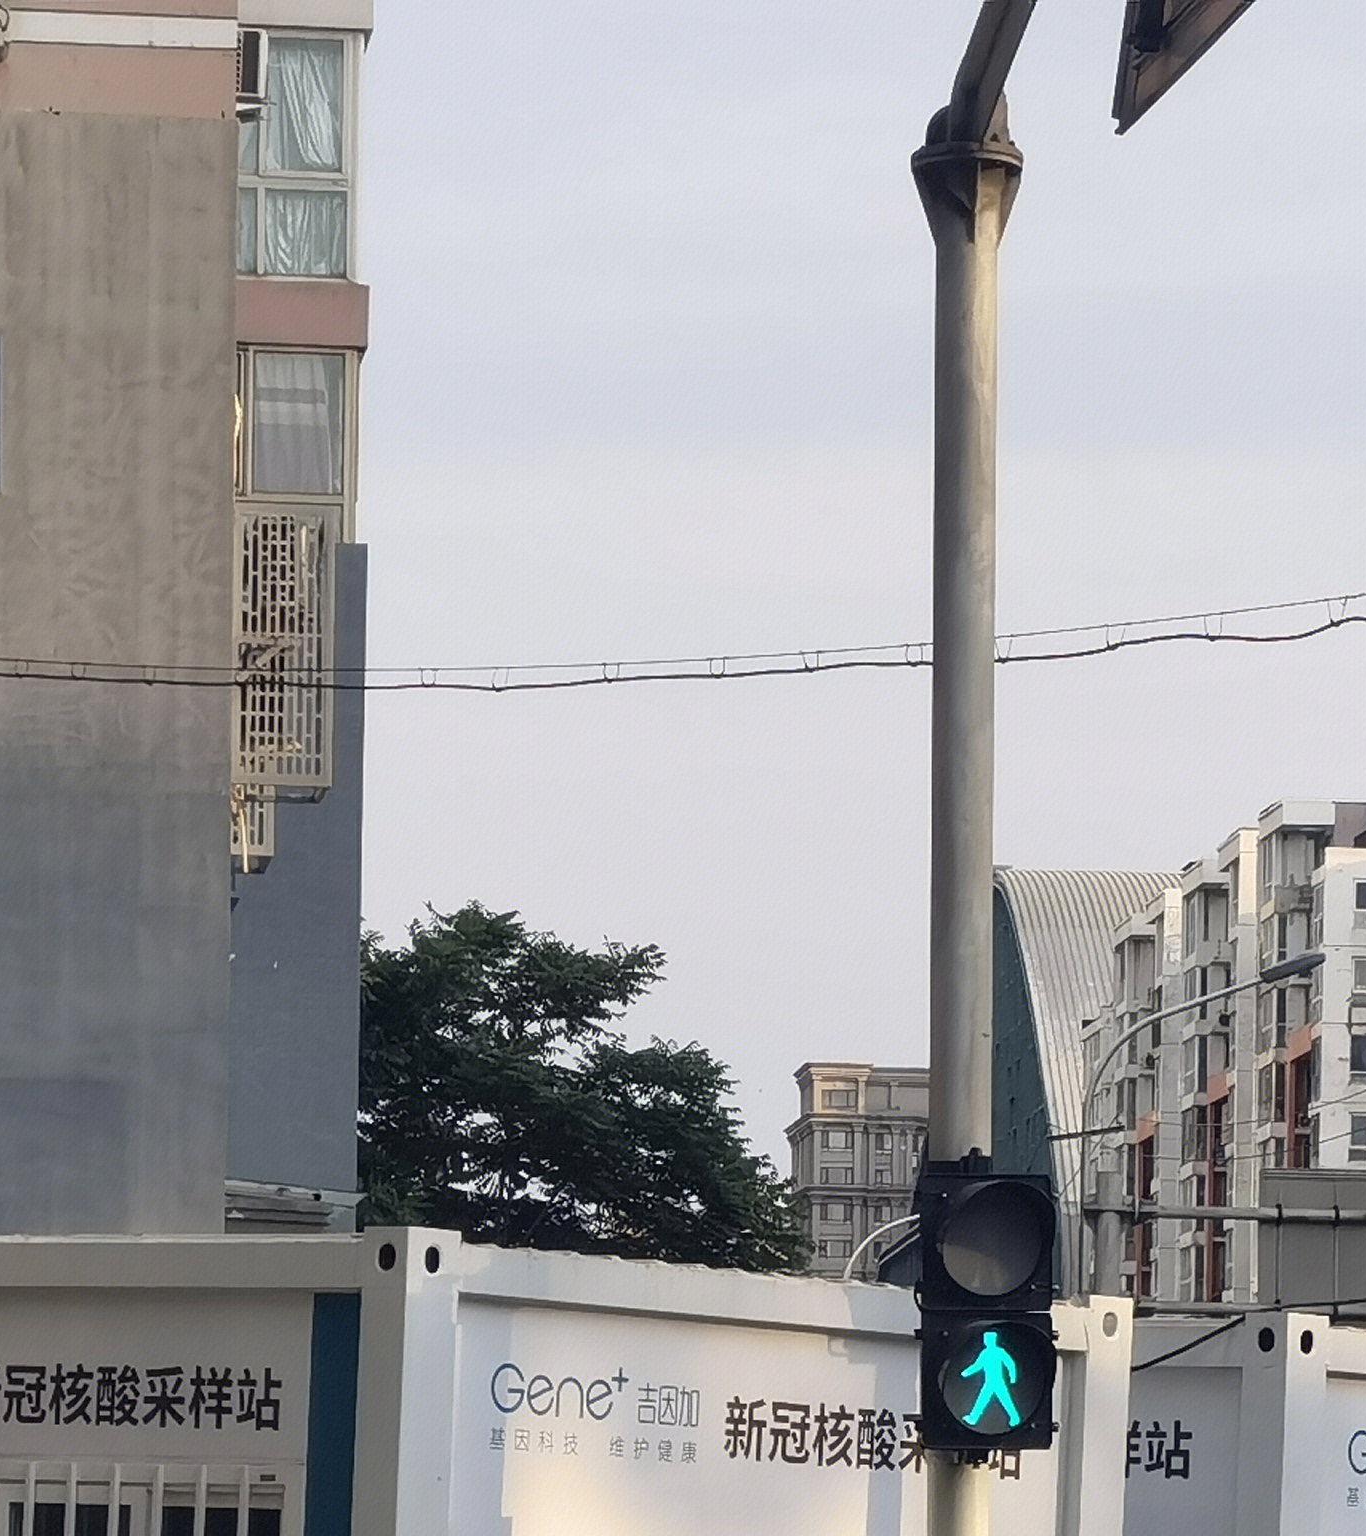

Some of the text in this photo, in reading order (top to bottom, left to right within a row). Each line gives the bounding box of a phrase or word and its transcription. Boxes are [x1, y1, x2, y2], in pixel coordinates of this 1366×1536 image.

[638, 1383, 701, 1428] 吉因加
[489, 1427, 698, 1464] 基因科技 维护健康
